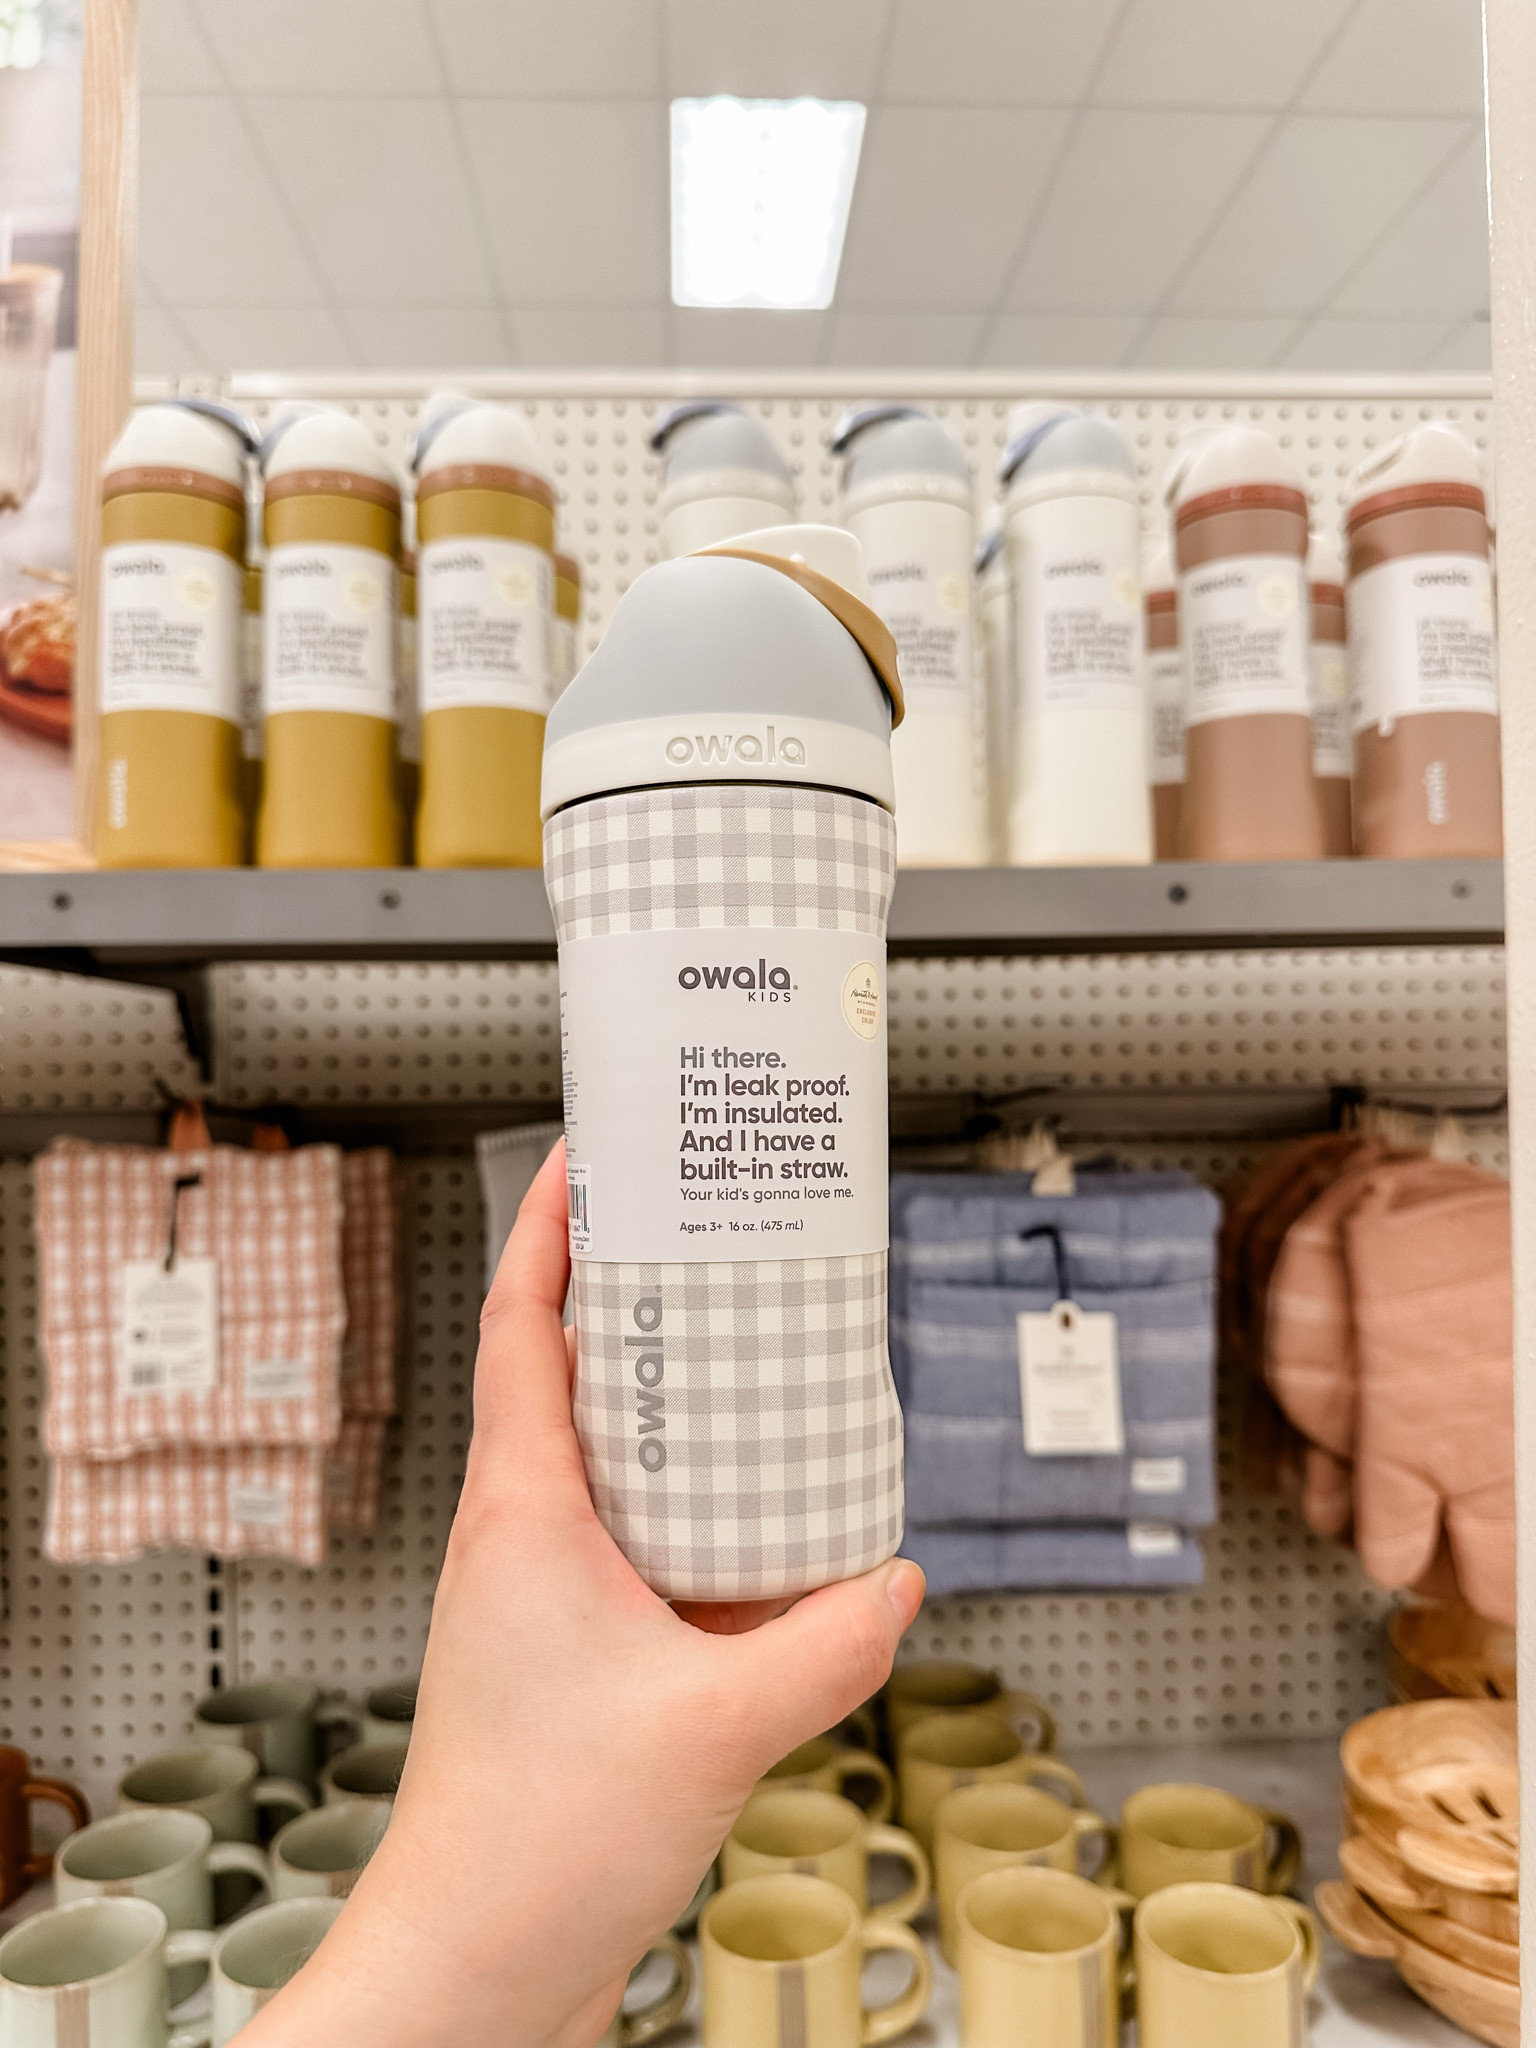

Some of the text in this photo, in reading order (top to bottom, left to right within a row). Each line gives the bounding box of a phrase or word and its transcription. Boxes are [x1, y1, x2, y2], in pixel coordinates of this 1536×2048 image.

[666, 726, 806, 766] owala
[677, 958, 792, 990] owala
[748, 991, 792, 1003] KIDS
[680, 1046, 787, 1069] Hi there.
[680, 1073, 850, 1102] I'm leak proof.
[680, 1101, 843, 1125] I'm insulated.
[679, 1129, 836, 1153] And I have a
[680, 1157, 849, 1181] built-in straw.
[680, 1186, 855, 1204] Your kid's gonna love me.
[679, 1219, 804, 1235] Ages 3+ 16 oz. (475 mL)
[624, 1296, 667, 1472] owala
